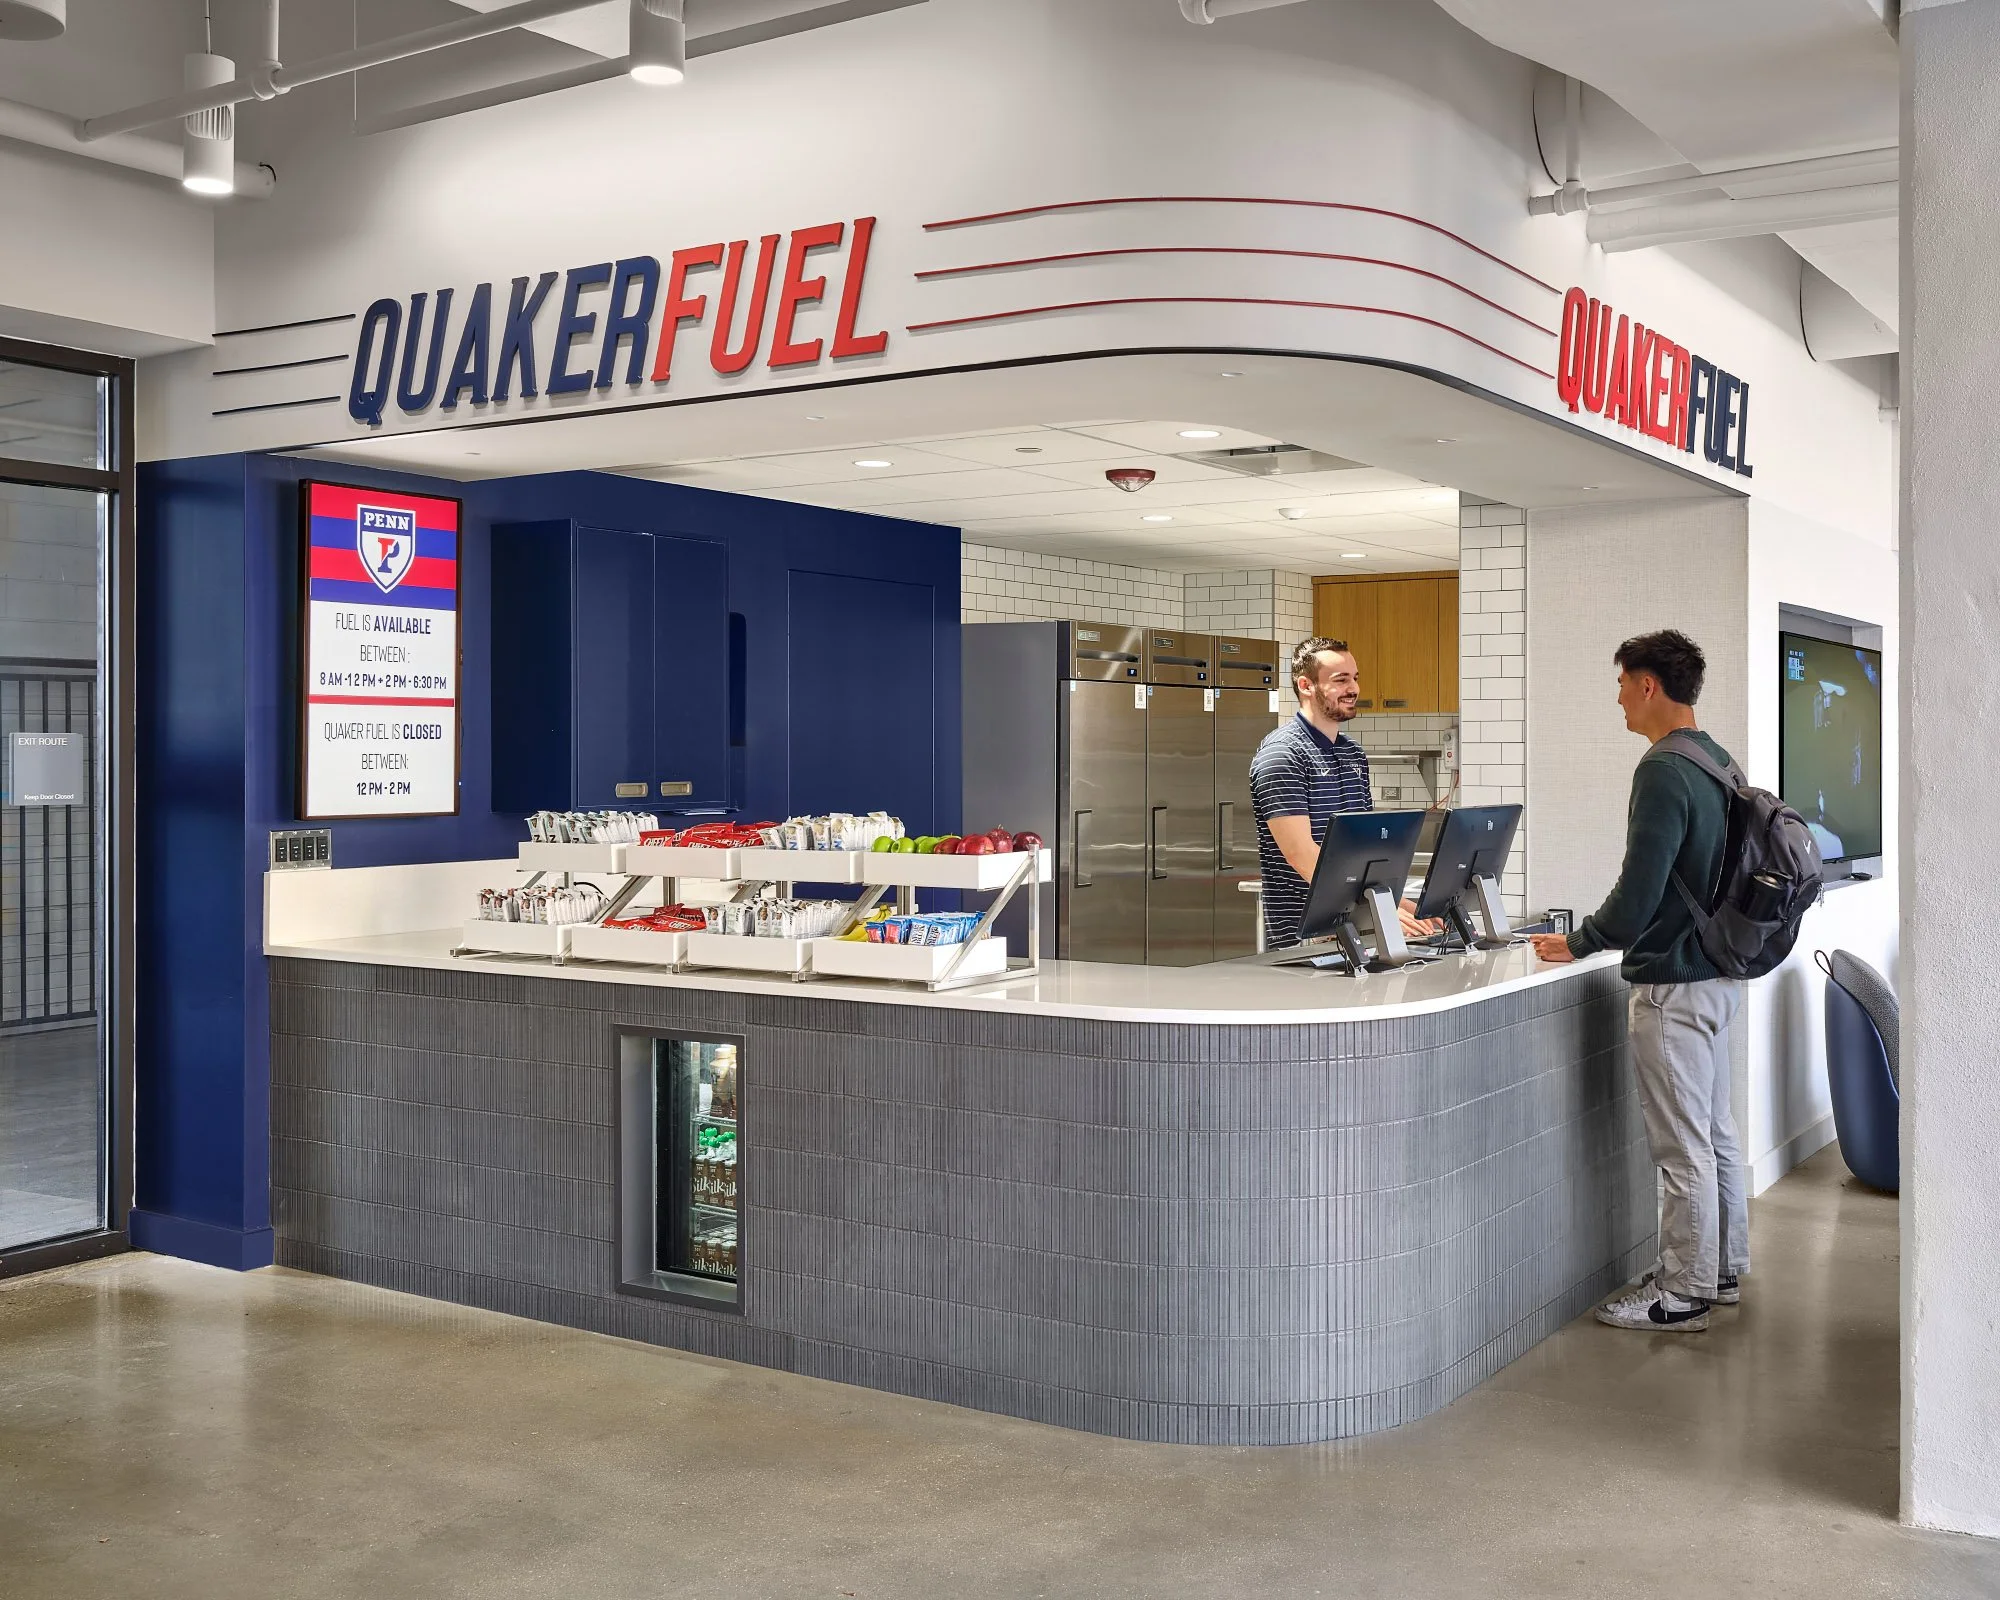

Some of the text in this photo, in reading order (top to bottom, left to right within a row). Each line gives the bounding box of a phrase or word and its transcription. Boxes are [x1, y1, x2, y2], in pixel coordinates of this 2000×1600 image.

[363, 511, 411, 531] PENN
[335, 612, 431, 635] FUEL IS AVAILABLE
[320, 671, 326, 686] 8
[328, 672, 343, 686] AM
[362, 673, 376, 687] PM
[385, 674, 392, 688] 2
[393, 675, 407, 689] PM
[413, 675, 432, 689] 6:30
[434, 676, 447, 690] PM
[18, 737, 68, 746] EXIT ROUTE
[324, 722, 442, 742] QUAKER FUEL IS CLOSED
[361, 753, 409, 770] BETWEEN:
[356, 782, 367, 795] 12
[369, 781, 383, 796] PM
[389, 781, 395, 795] 2
[397, 781, 411, 795] PM
